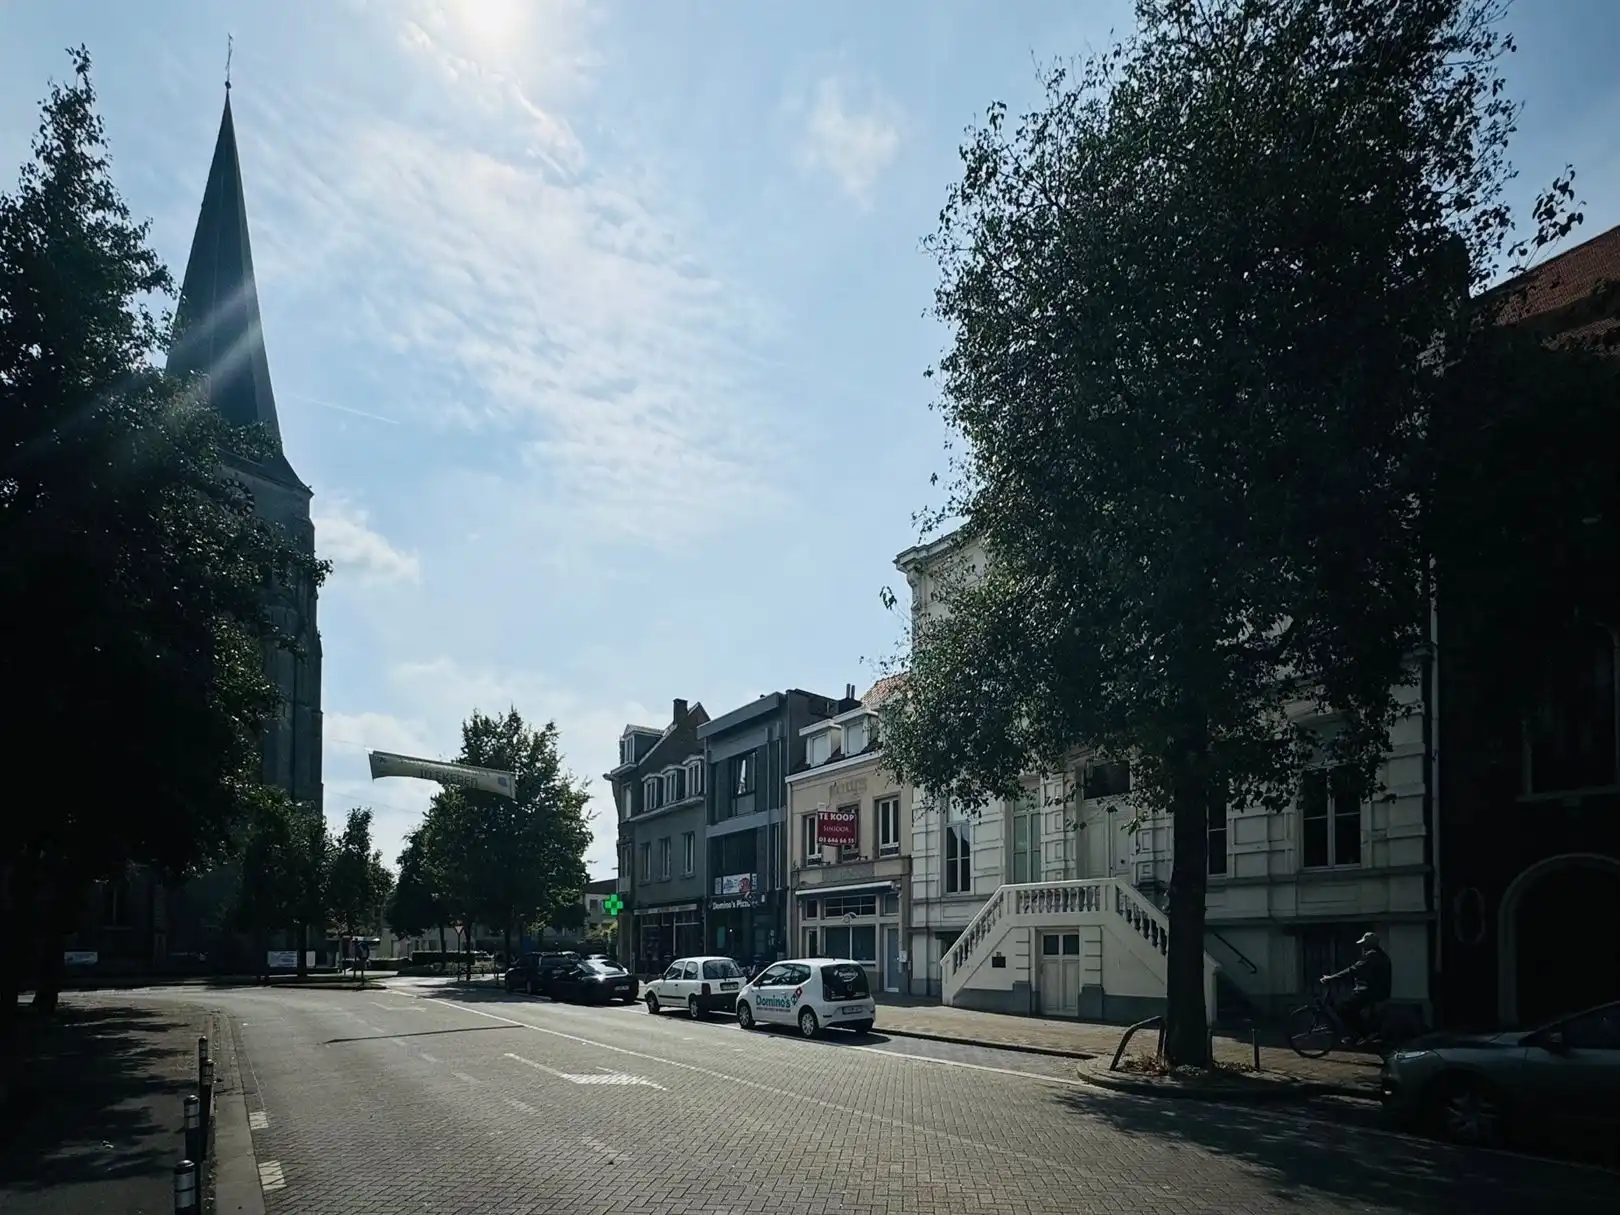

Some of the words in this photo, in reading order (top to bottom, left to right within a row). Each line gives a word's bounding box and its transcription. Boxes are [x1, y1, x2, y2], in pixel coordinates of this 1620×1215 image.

[819, 812, 829, 820] TE
[830, 812, 854, 821] KOOP
[712, 900, 735, 910] Domino's
[756, 994, 791, 1008] Domino's
